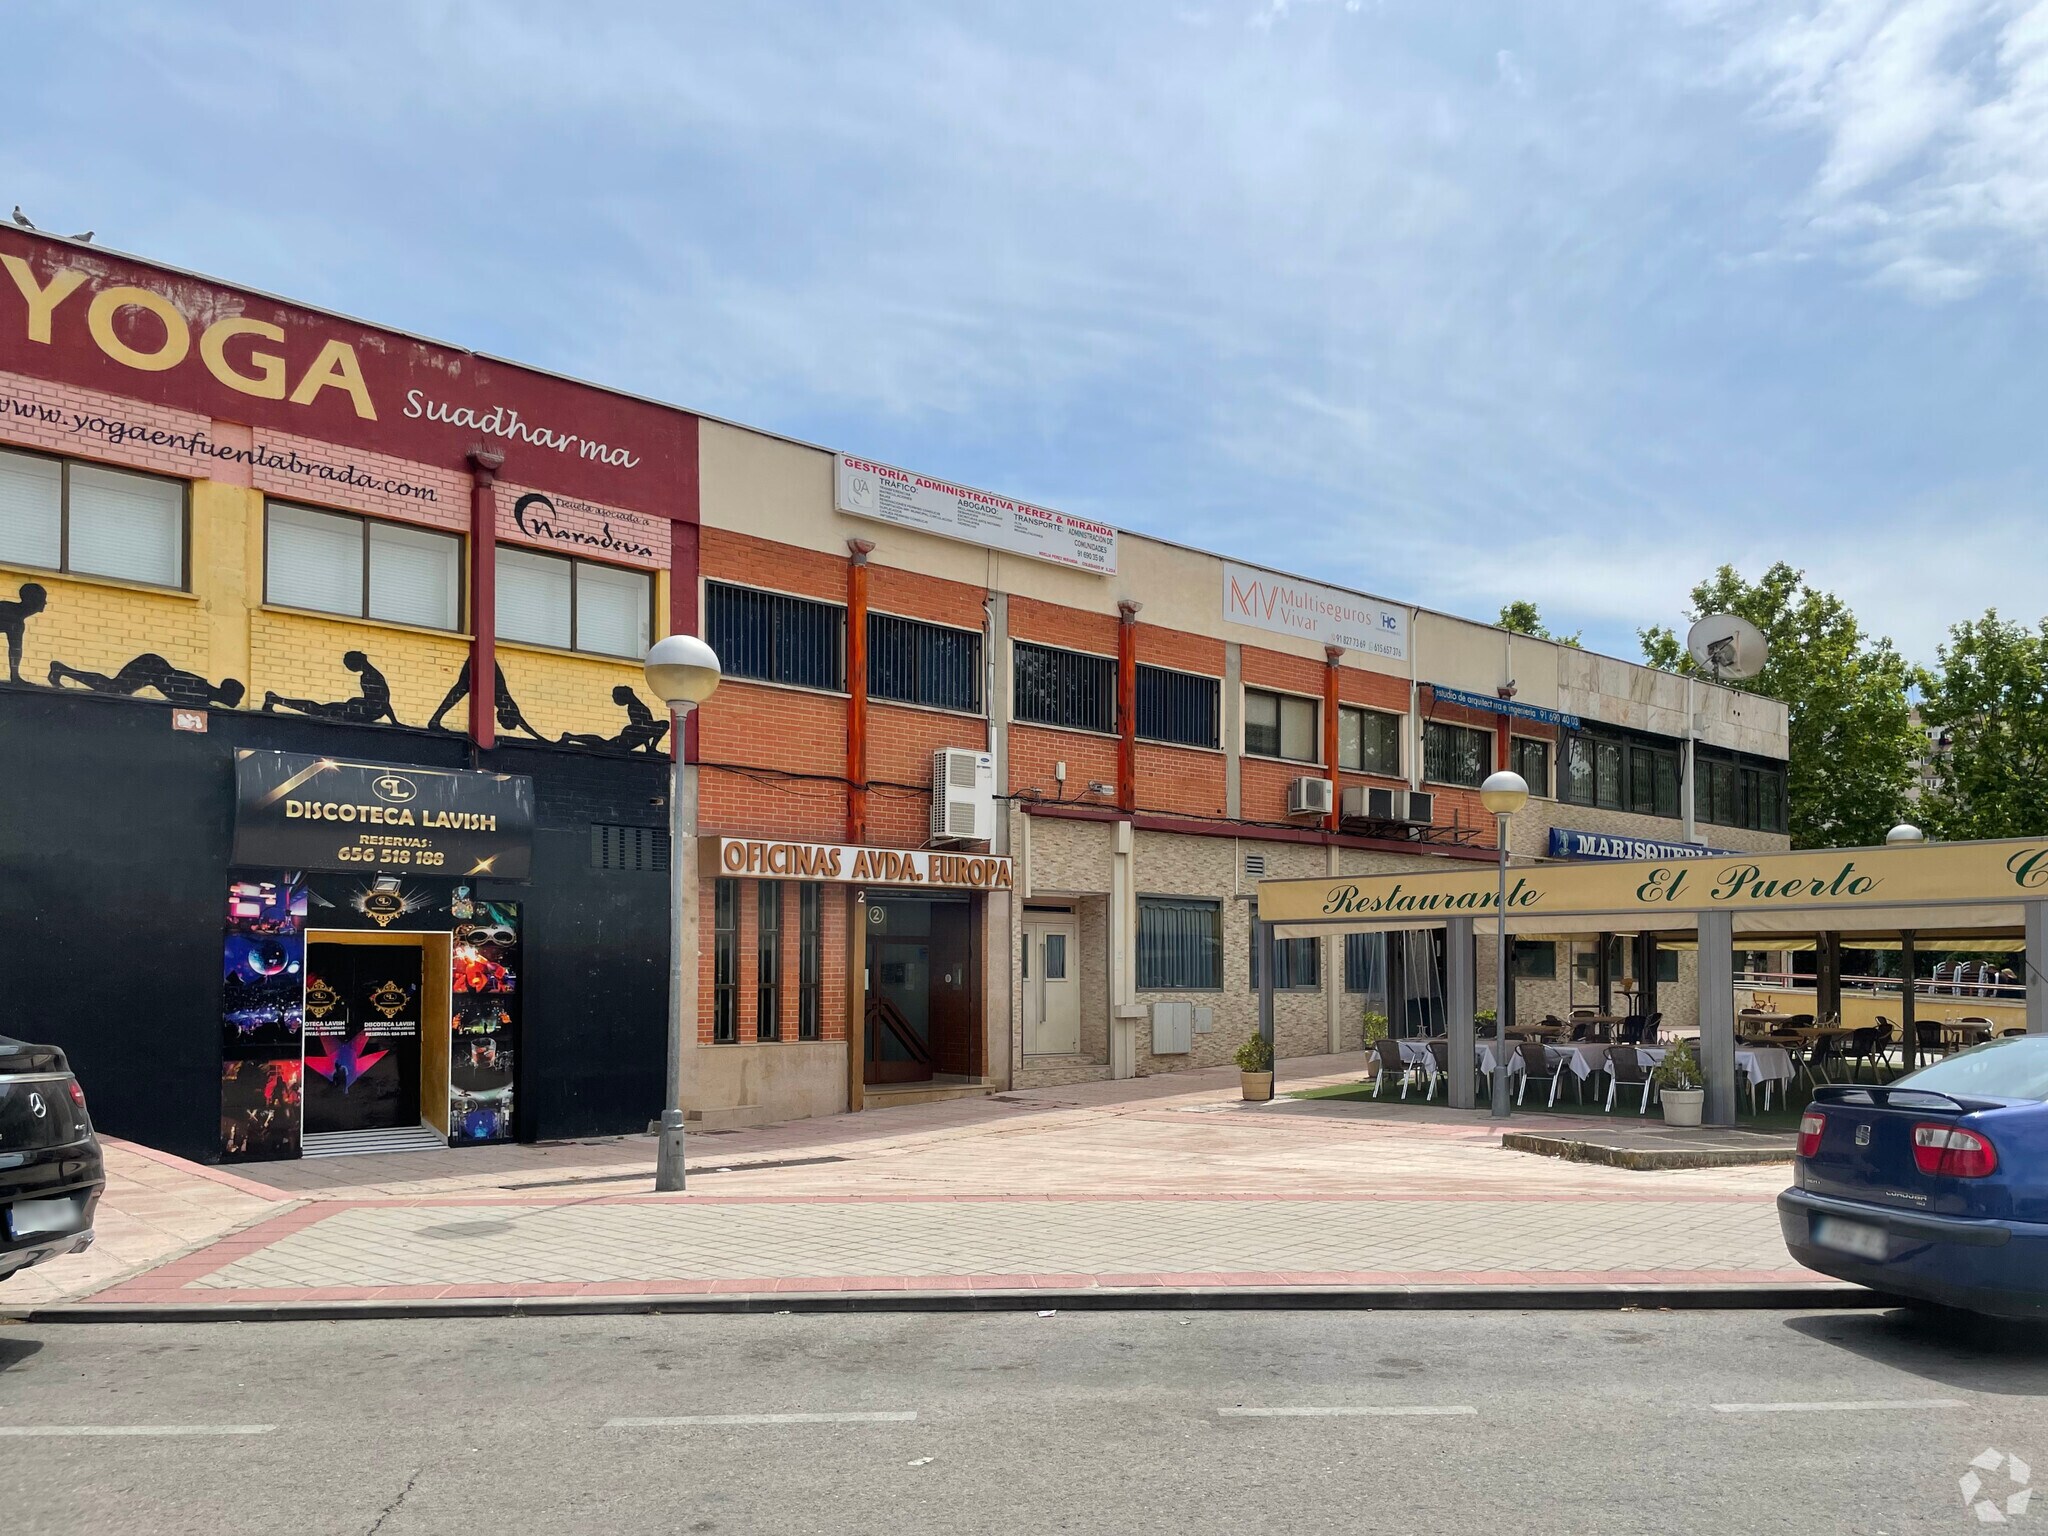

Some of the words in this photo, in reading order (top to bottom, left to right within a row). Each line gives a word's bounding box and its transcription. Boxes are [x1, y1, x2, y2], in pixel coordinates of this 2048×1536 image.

[0, 252, 378, 421] YOGA
[402, 388, 641, 469] Suadharma
[915, 478, 1014, 511] ADMINISTRATIVA
[1018, 505, 1053, 524] PÉREZ
[1055, 515, 1064, 524] &
[1066, 518, 1113, 537] MIRANDA
[1281, 587, 1372, 625] Multiseguros
[1281, 608, 1318, 631] Vivar
[1458, 692, 1466, 702] de
[1540, 710, 1547, 720] 91
[285, 799, 415, 827] DISCOTECA
[422, 810, 496, 832] LAVISH
[338, 846, 375, 862] 656
[379, 849, 411, 865] 518
[415, 851, 445, 866] 188
[359, 834, 432, 848] RESERVAS:
[723, 841, 841, 877] OFICINAS
[852, 850, 923, 881] AVDA.
[928, 855, 1012, 886] EUROPA
[857, 891, 865, 903] 2
[1323, 877, 1548, 914] Restaurante
[1636, 868, 1690, 902] El
[1710, 862, 1885, 900] Puerto
